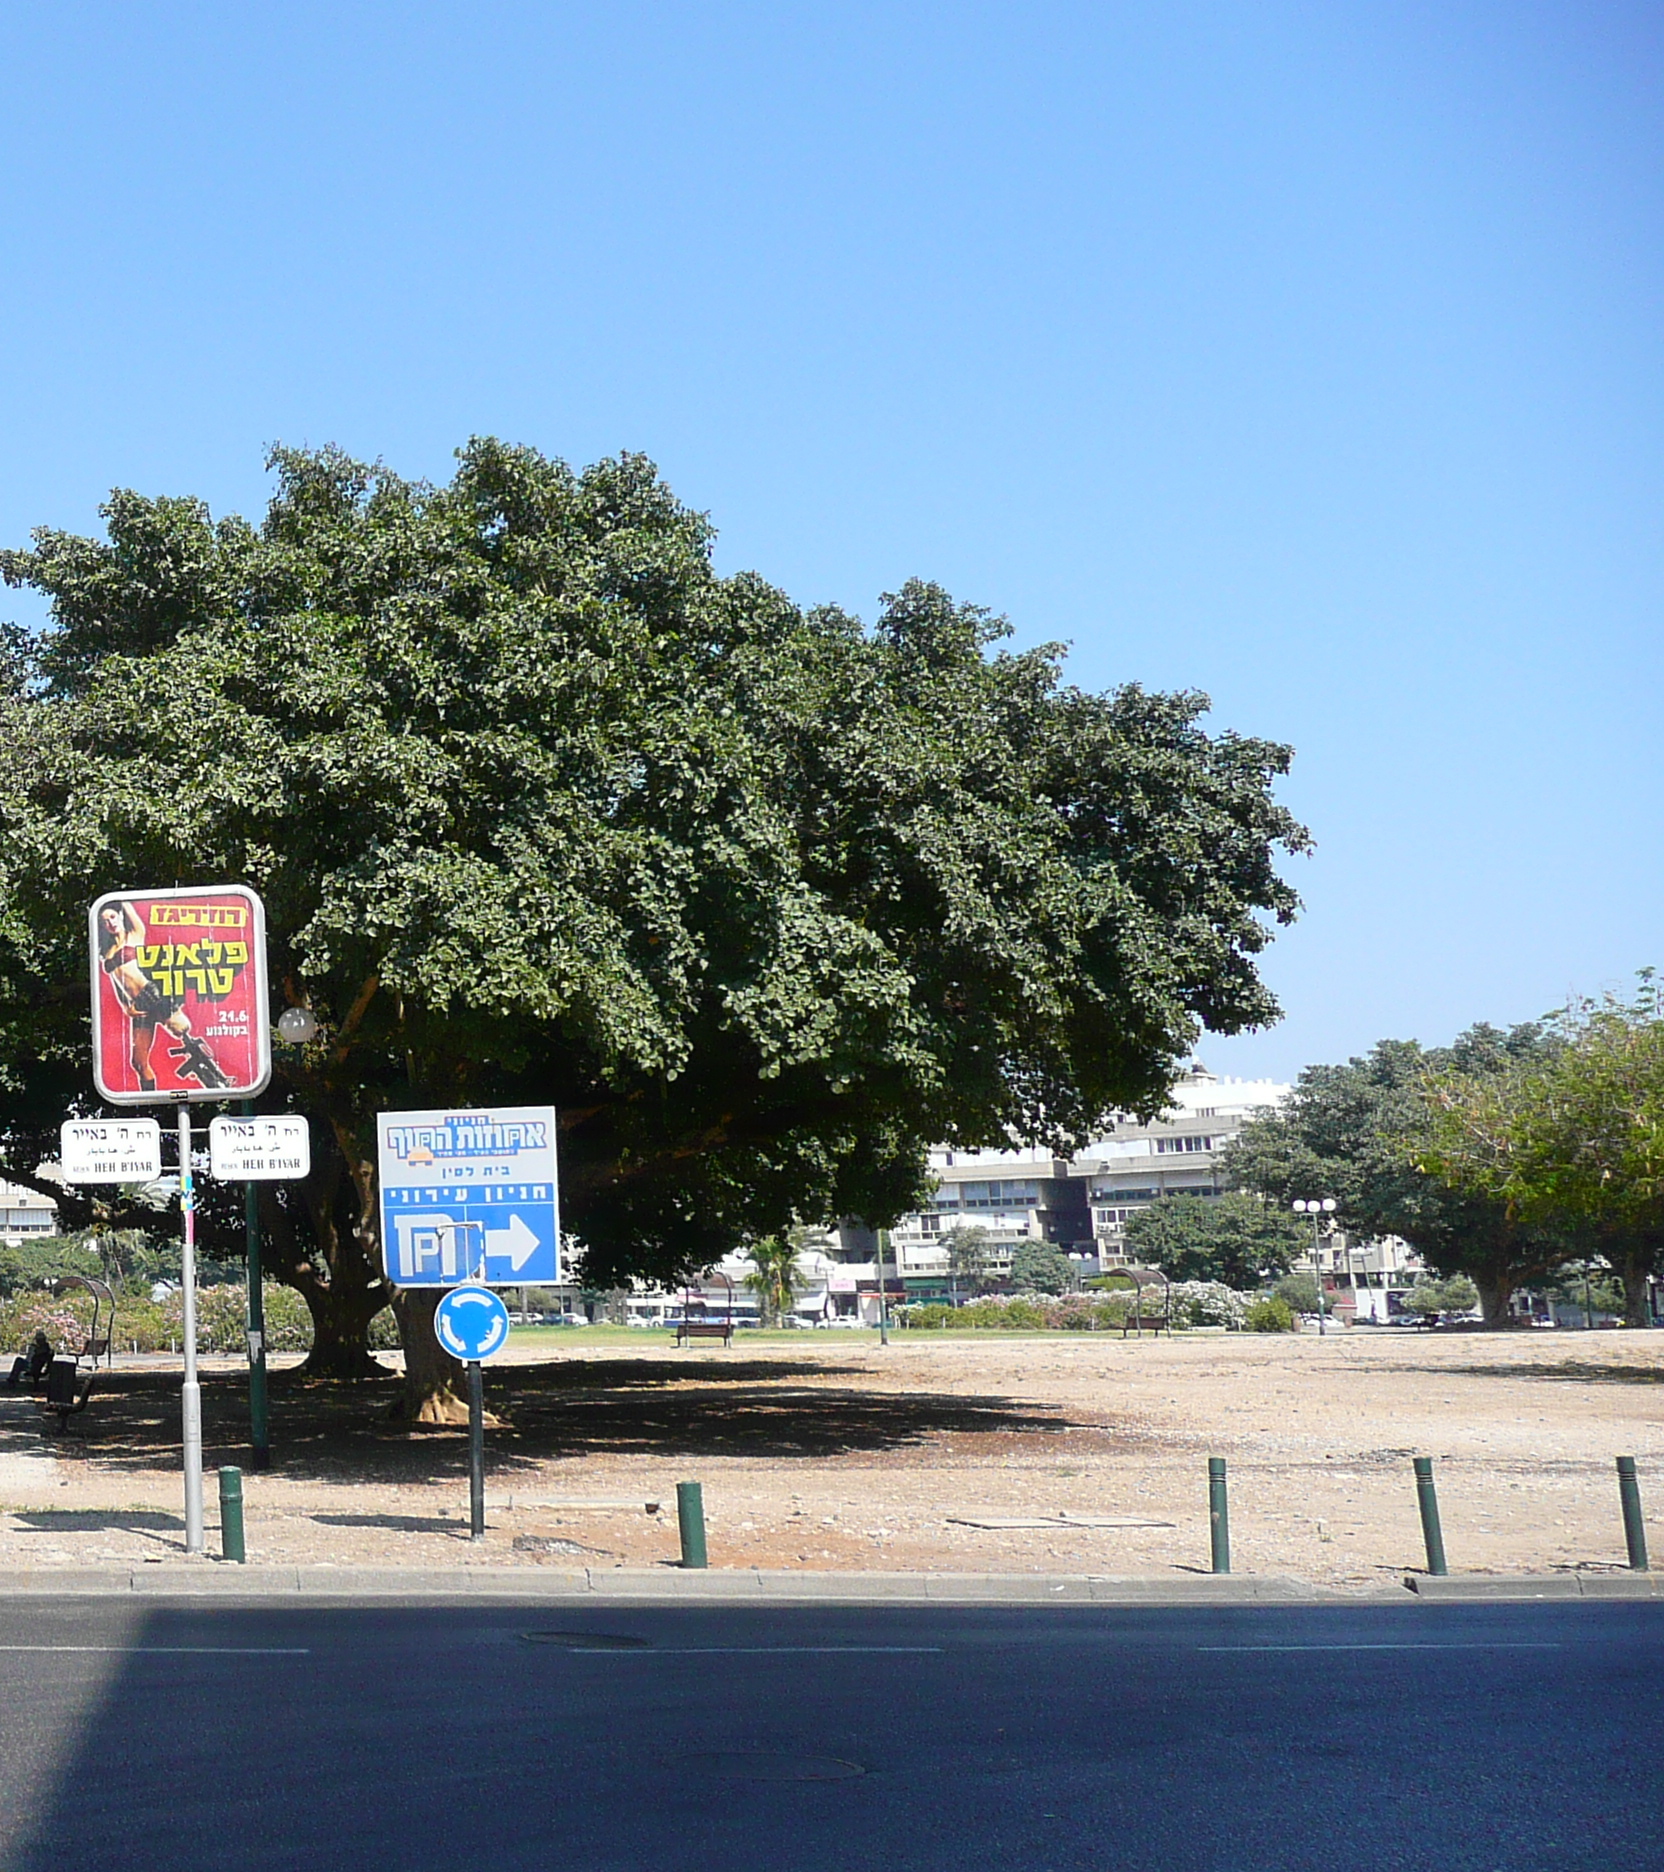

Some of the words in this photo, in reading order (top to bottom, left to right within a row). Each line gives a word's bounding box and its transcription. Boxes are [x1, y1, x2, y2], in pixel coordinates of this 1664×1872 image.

[156, 908, 240, 924] רודריגז
[136, 937, 249, 968] פלאנט
[151, 968, 234, 996] טרור
[219, 1010, 247, 1023] 21.6
[206, 1024, 249, 1038] בקולנוע
[447, 1116, 487, 1125] חניוני
[72, 1128, 107, 1140] באייר
[220, 1125, 255, 1137] באייר
[457, 1123, 546, 1150] אחוזות
[94, 1162, 116, 1173] HEH
[121, 1161, 152, 1172] B'IYAR
[242, 1159, 264, 1169] HEH
[442, 1167, 474, 1179] לסין
[483, 1166, 510, 1177] בית
[390, 1188, 467, 1203] עירוני
[485, 1186, 546, 1202] חניון
